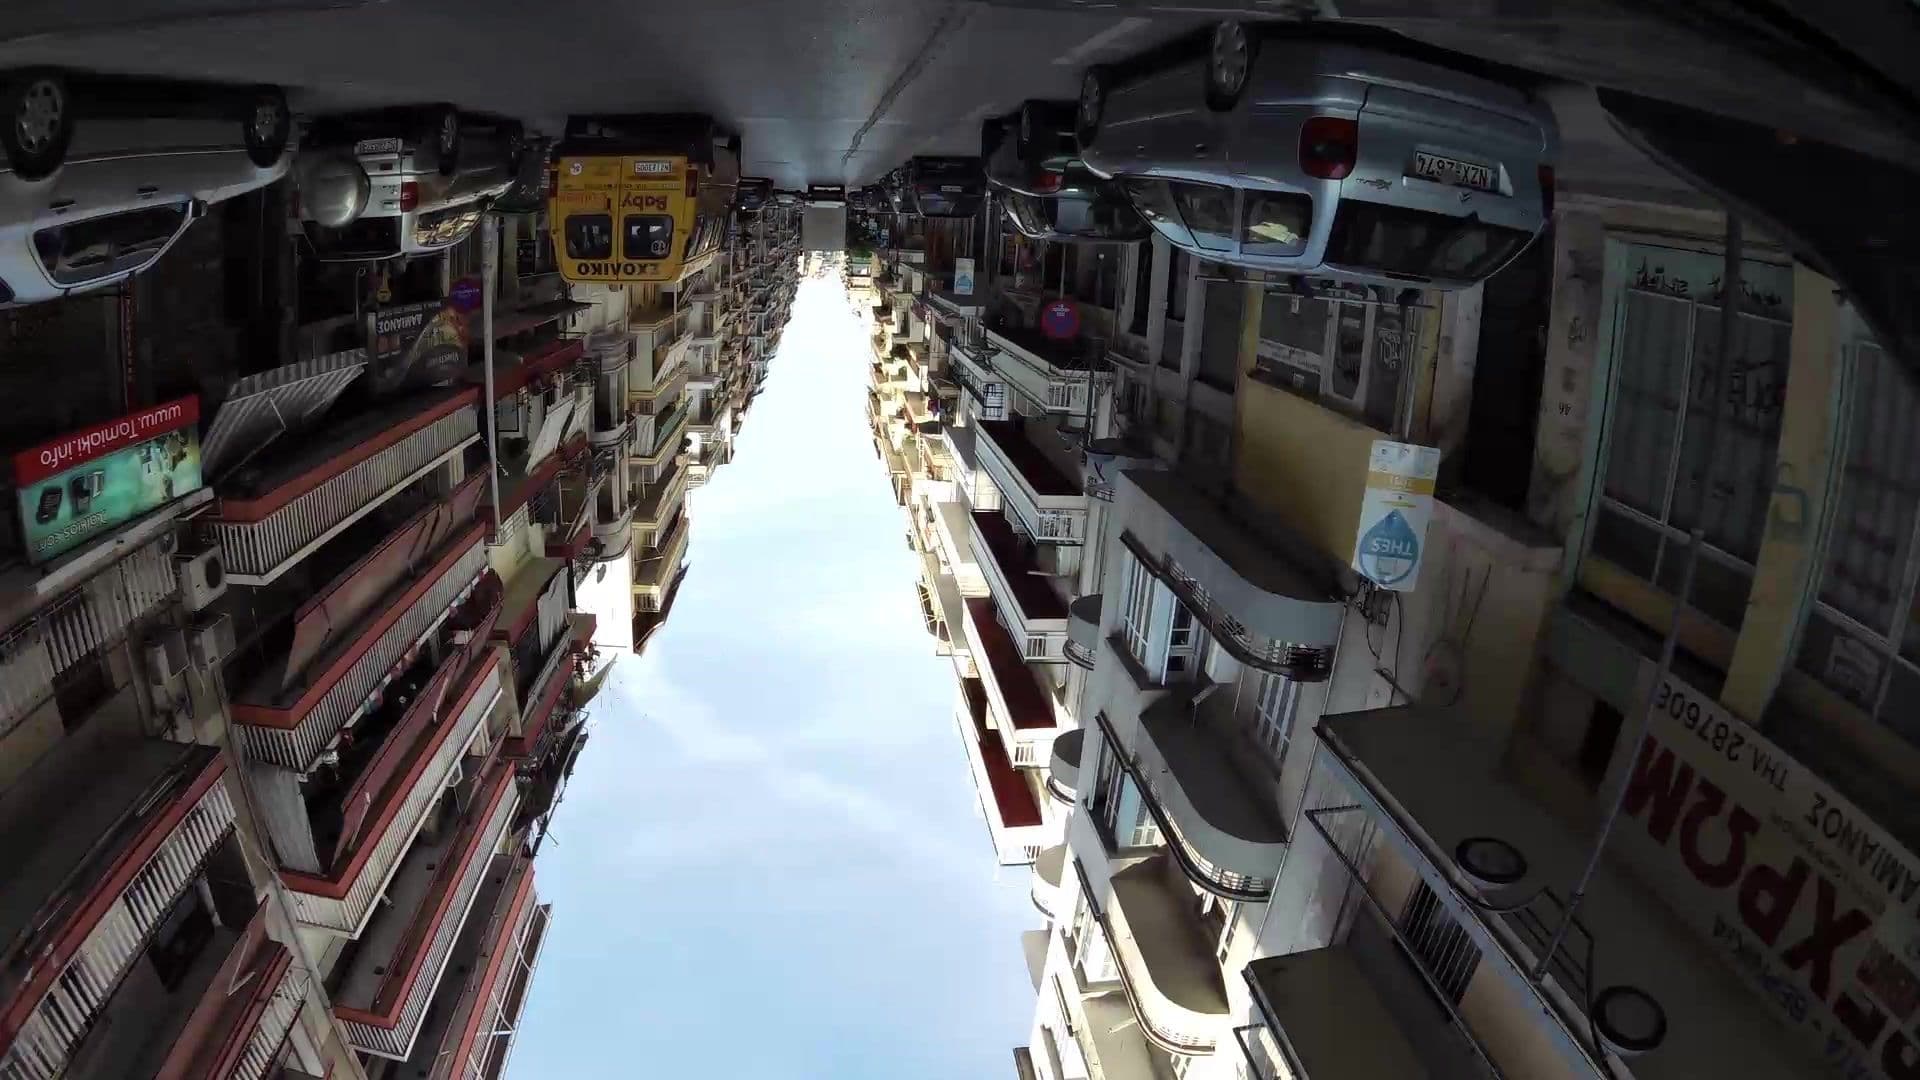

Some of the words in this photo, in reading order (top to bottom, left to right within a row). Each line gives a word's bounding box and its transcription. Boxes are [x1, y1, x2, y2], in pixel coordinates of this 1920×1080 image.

[619, 192, 668, 211] Baby
[577, 263, 658, 276] ΣΧΟΛΙΚΟ
[1370, 538, 1413, 556] THES
